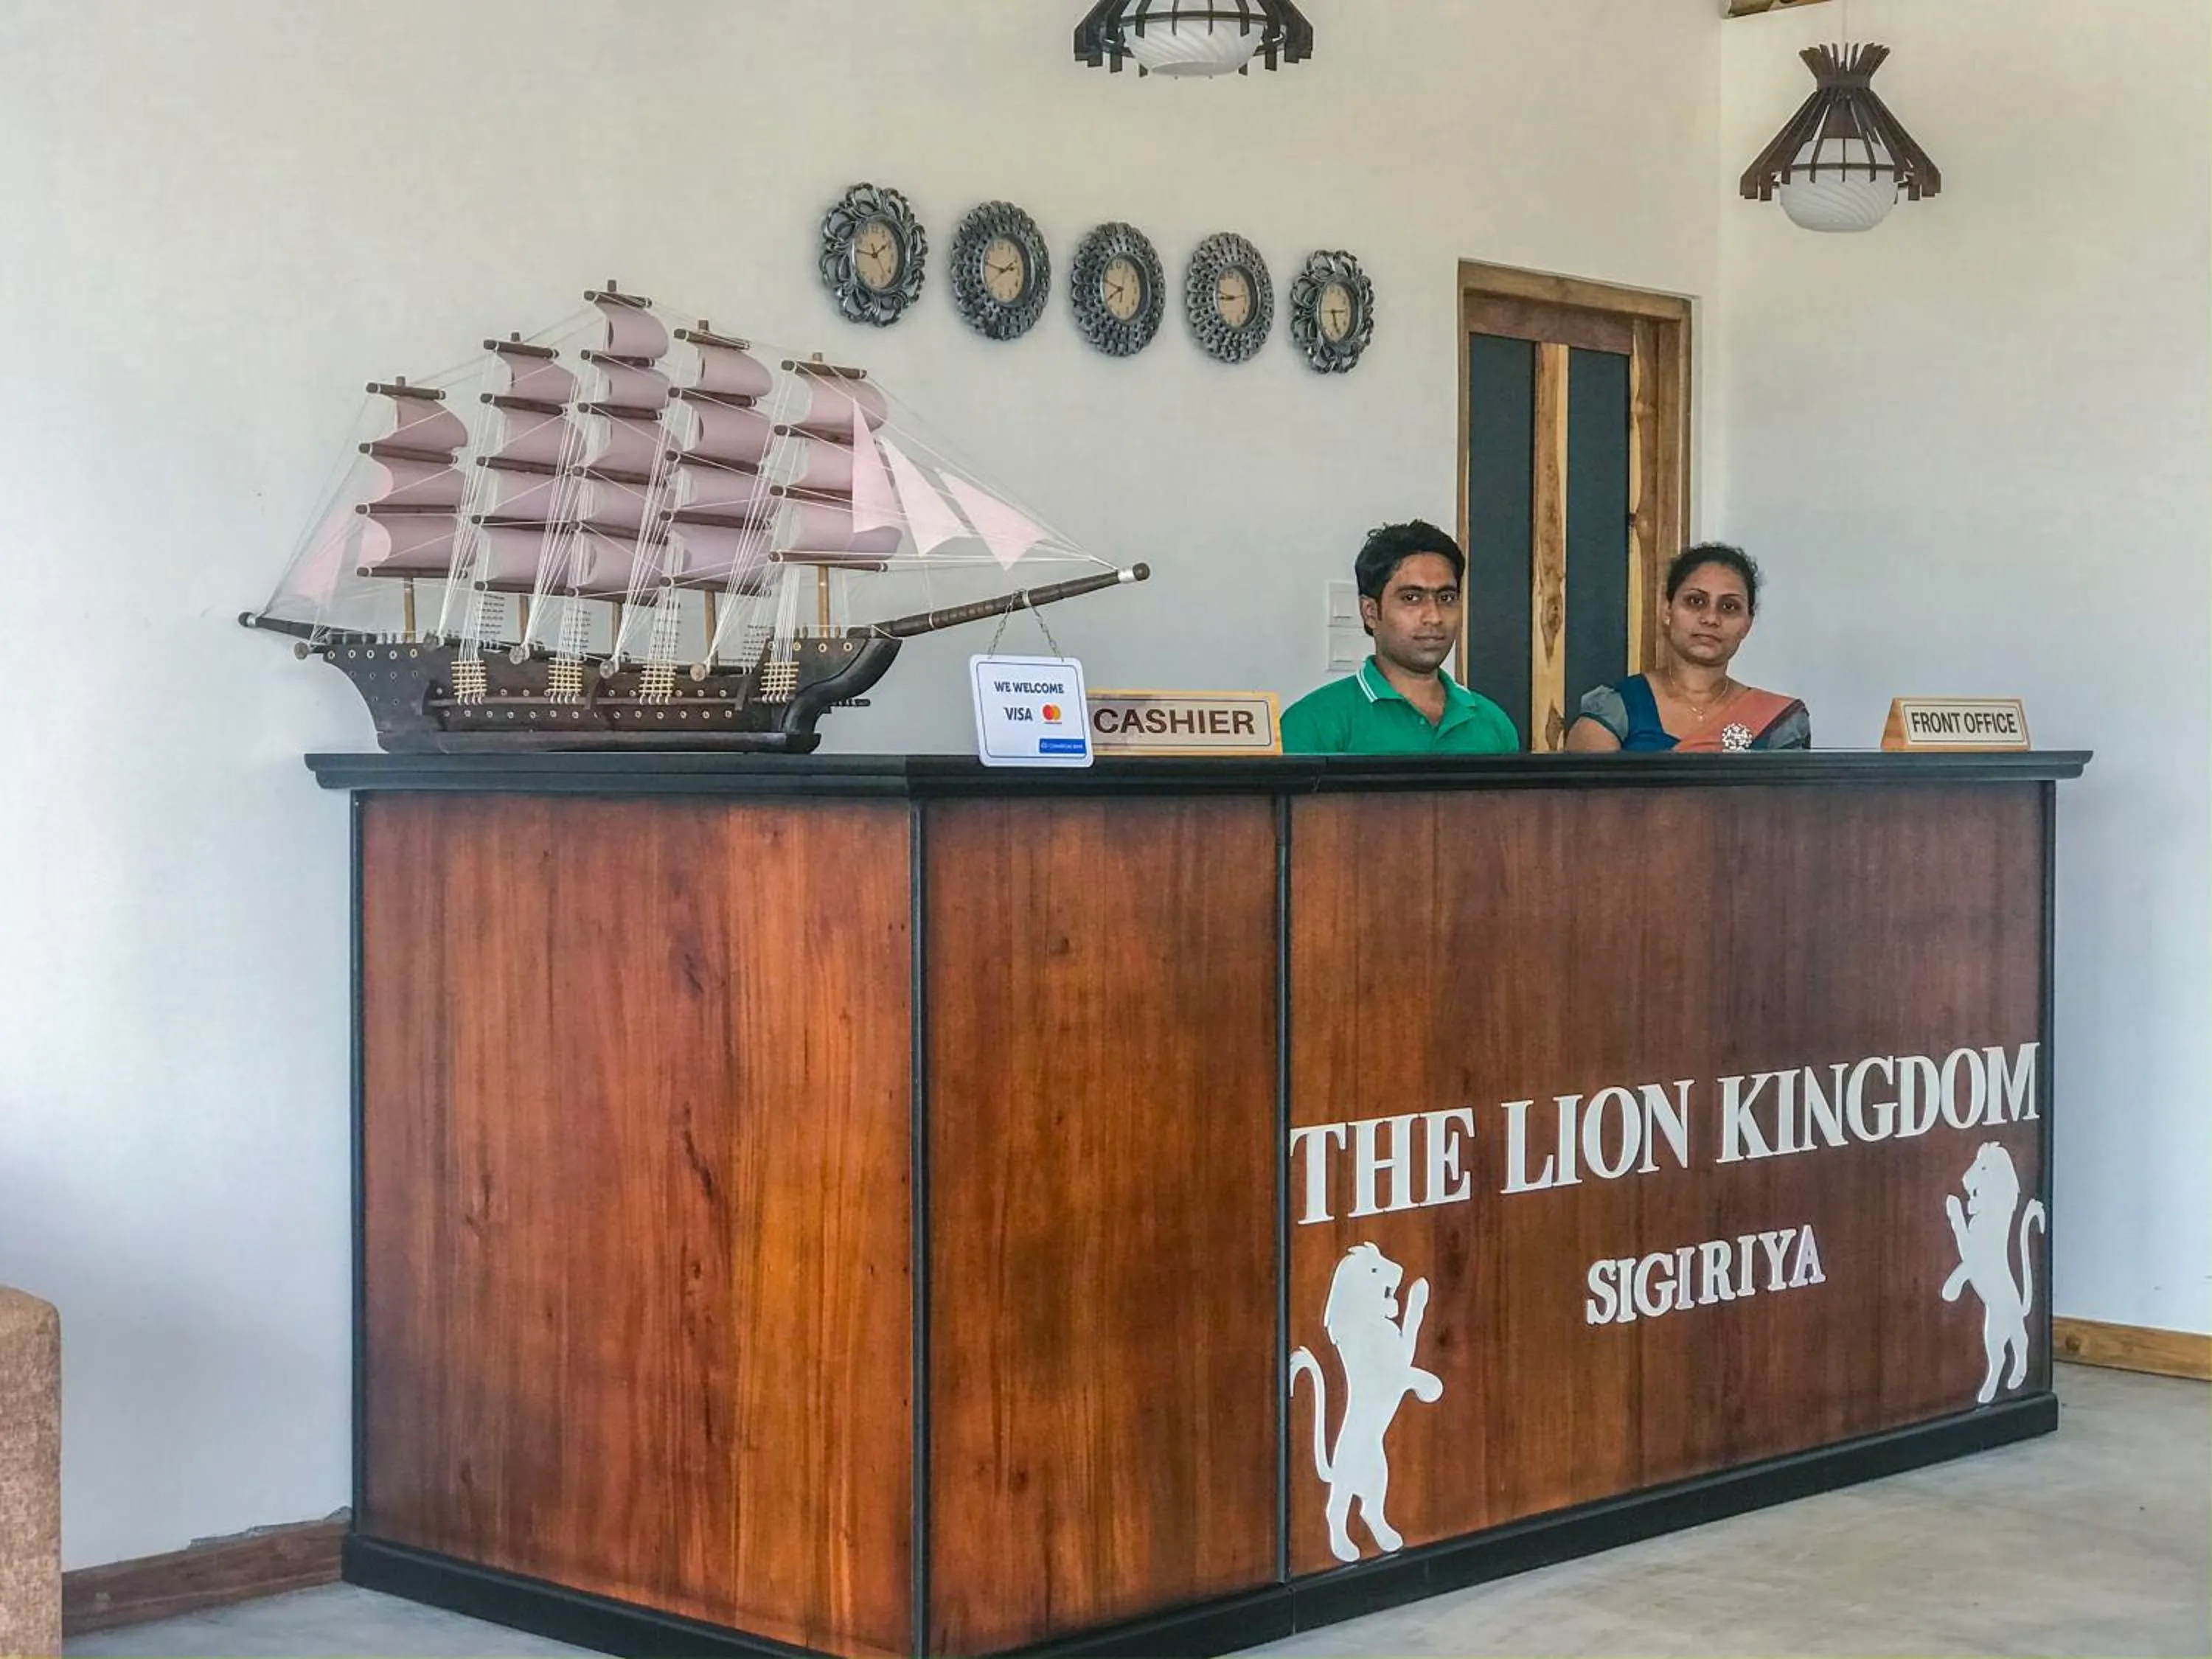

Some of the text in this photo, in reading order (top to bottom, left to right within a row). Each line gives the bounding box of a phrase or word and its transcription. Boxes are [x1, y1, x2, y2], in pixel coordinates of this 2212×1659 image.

[994, 681, 1064, 694] WE WELCOME
[1004, 707, 1033, 721] VISA
[1093, 709, 1255, 735] CASHIER
[1911, 712, 2017, 734] FRONT OFFICE
[1290, 1042, 2040, 1225] THE LION KINGDOM
[1586, 1225, 1826, 1325] SIGIRIYA
